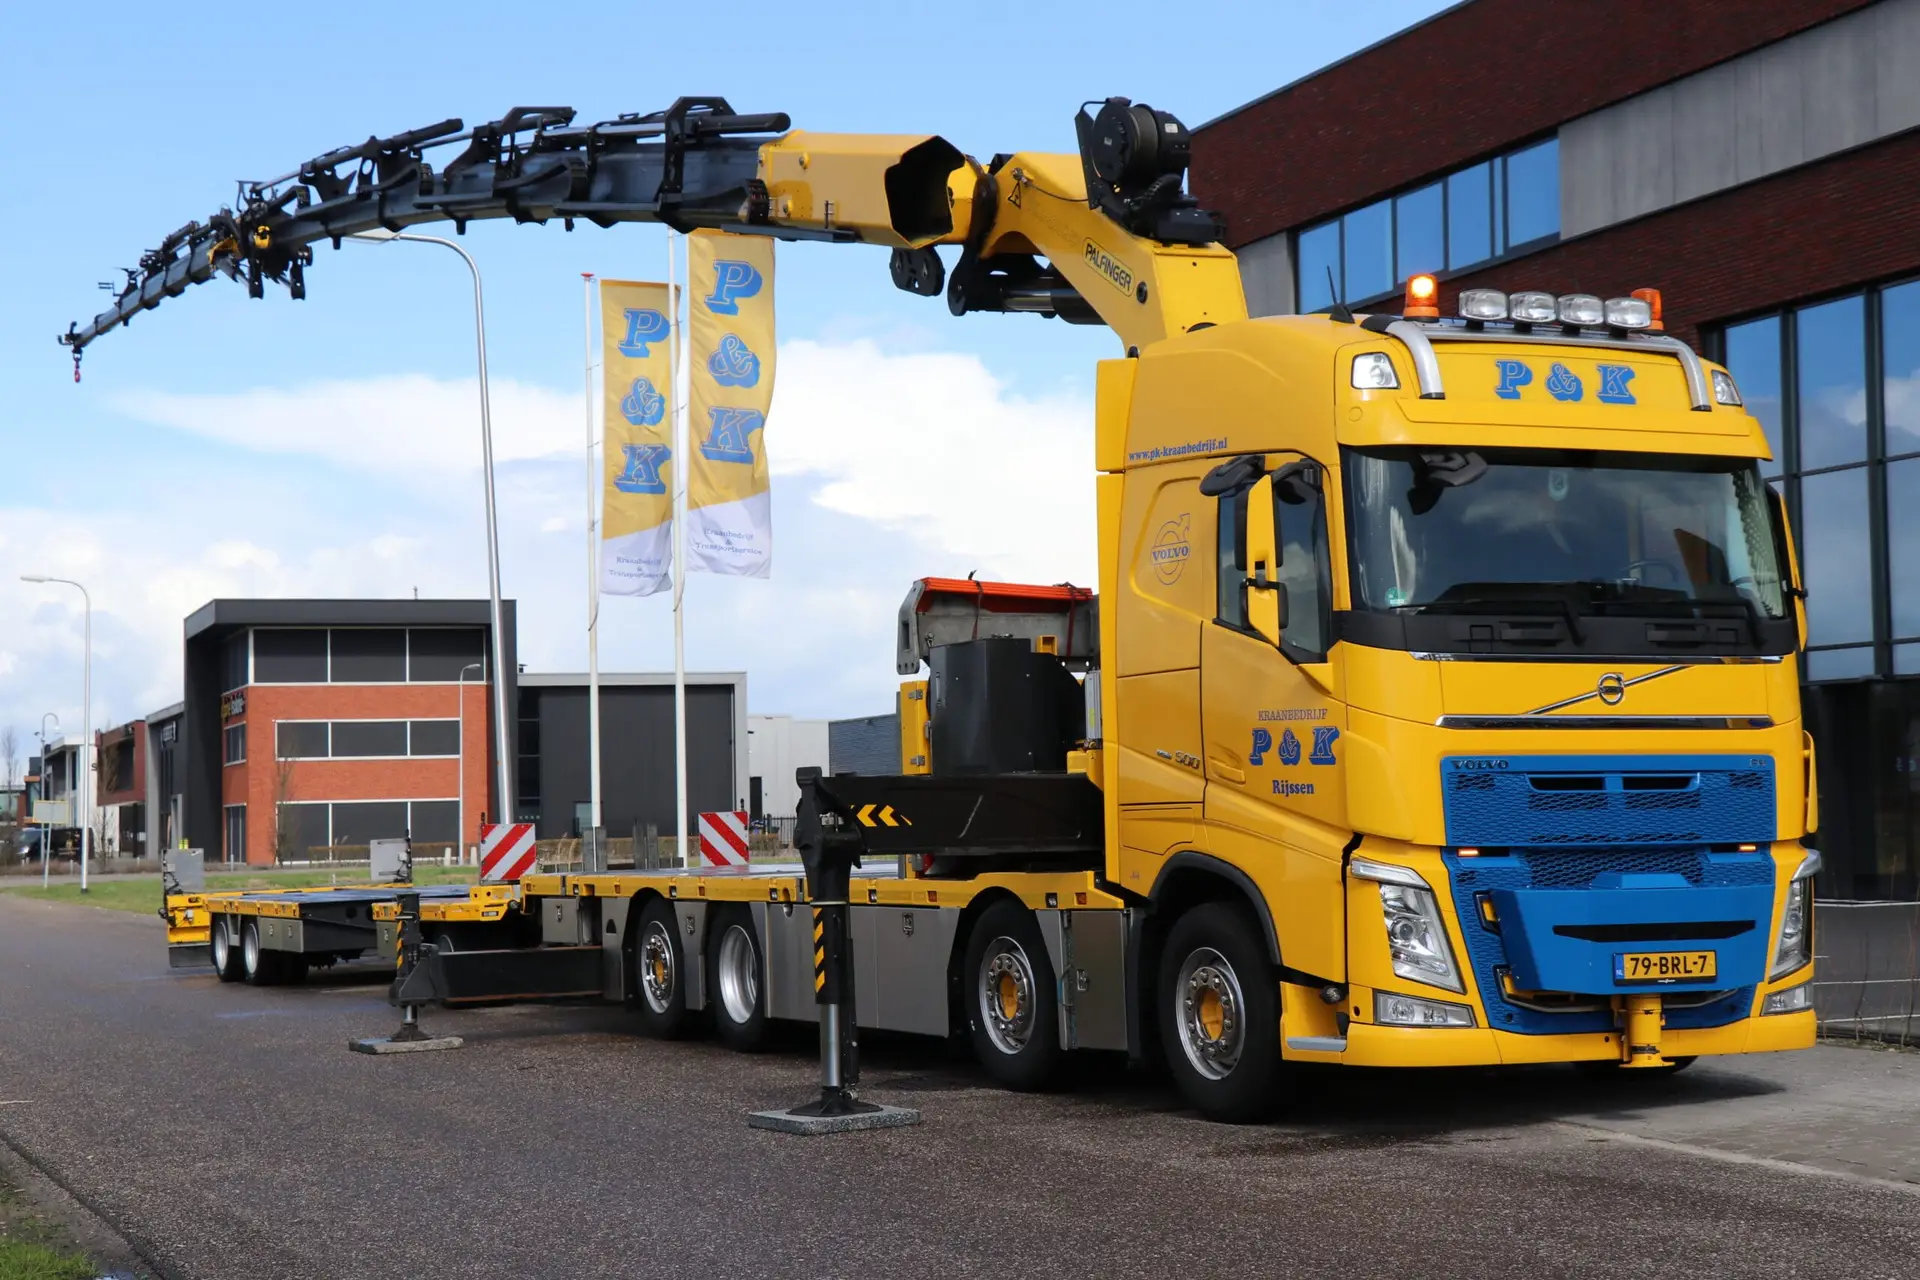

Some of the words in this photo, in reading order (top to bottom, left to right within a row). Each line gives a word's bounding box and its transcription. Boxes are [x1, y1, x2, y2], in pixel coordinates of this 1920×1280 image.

[704, 259, 763, 316] P
[1085, 243, 1132, 291] PALFINGER
[617, 308, 671, 358] P
[707, 333, 761, 388] &
[1494, 359, 1533, 400] P
[1545, 361, 1584, 402] &
[1596, 364, 1637, 405] K
[620, 376, 666, 426] &
[700, 406, 766, 465] K
[1128, 437, 1228, 461] www.pk-kraanbedrijf.nl
[614, 444, 672, 494] K
[1152, 546, 1189, 561] VOLVO
[1258, 708, 1328, 721] KRAANBEDRIJF
[1175, 750, 1200, 769] 500
[1249, 727, 1272, 766] P
[1278, 727, 1301, 766] &
[1308, 726, 1340, 765] K
[1451, 759, 1509, 770] VOLVO
[1272, 780, 1315, 797] Rijssen
[1630, 955, 1708, 976] 79-BRL-7
